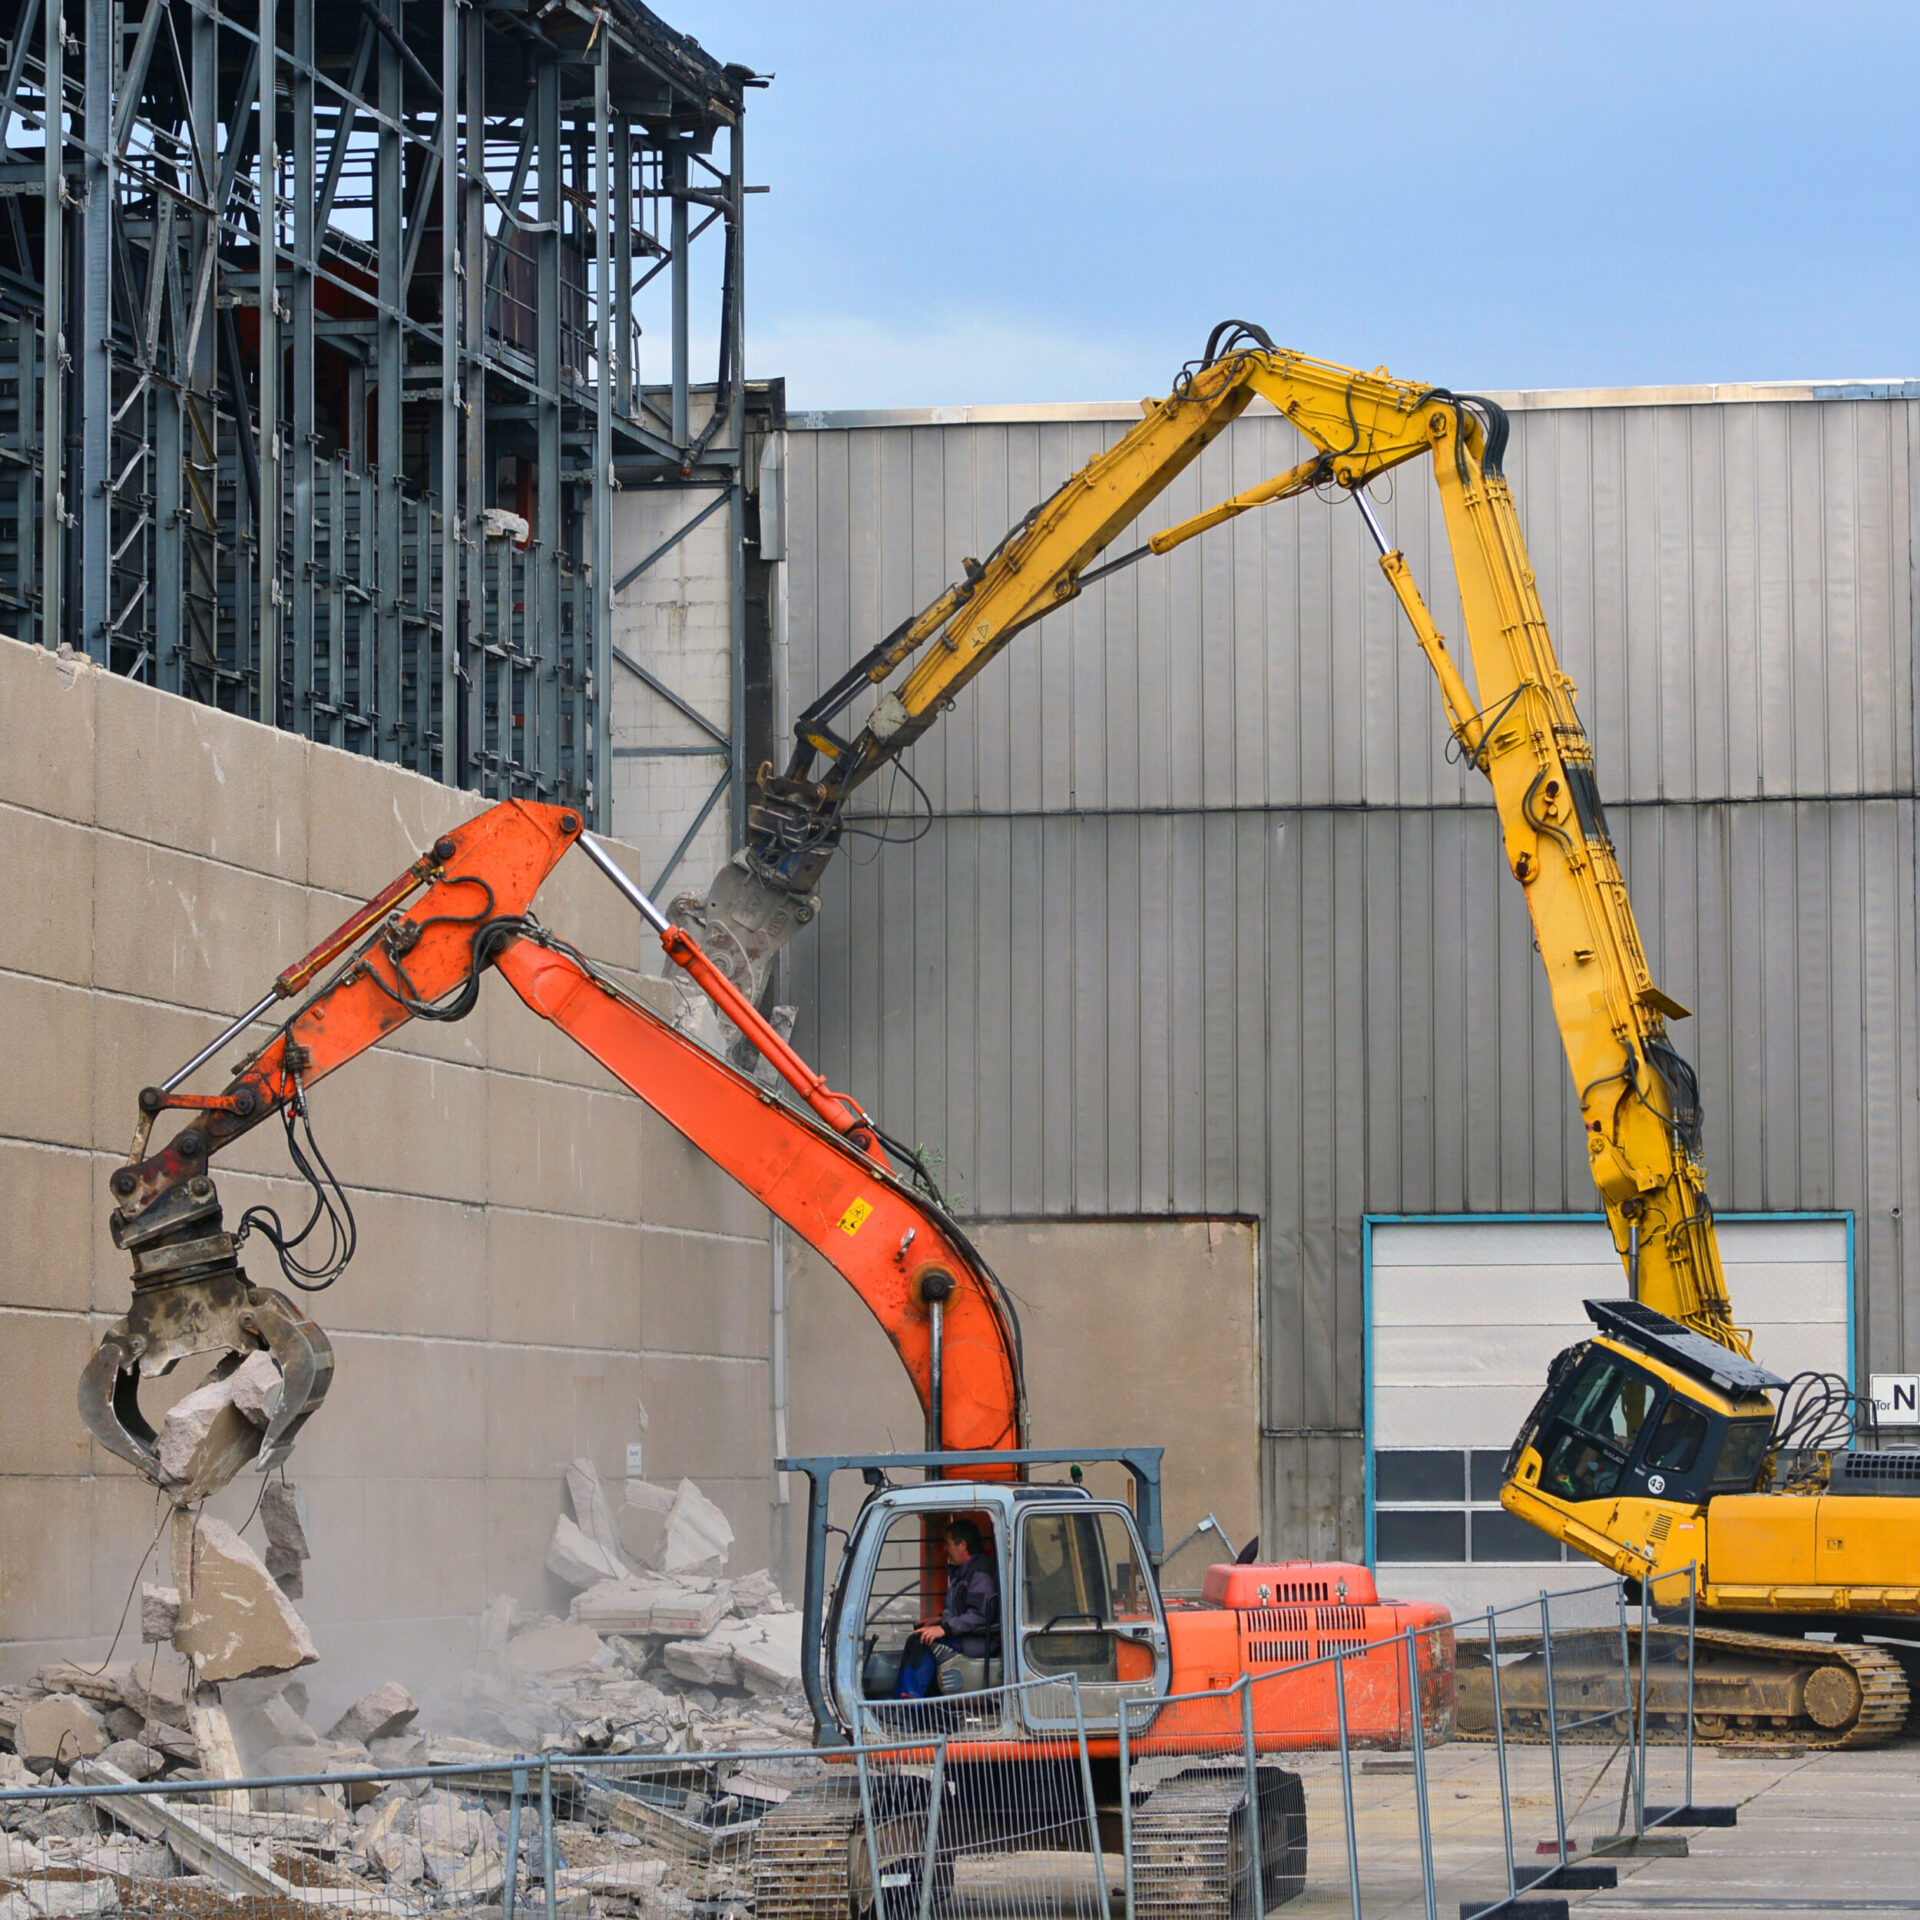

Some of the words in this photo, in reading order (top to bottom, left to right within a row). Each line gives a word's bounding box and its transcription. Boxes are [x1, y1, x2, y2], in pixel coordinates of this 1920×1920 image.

[1875, 1399, 1891, 1411] Tor
[1893, 1384, 1915, 1410] N
[1650, 1478, 1663, 1491] 43
